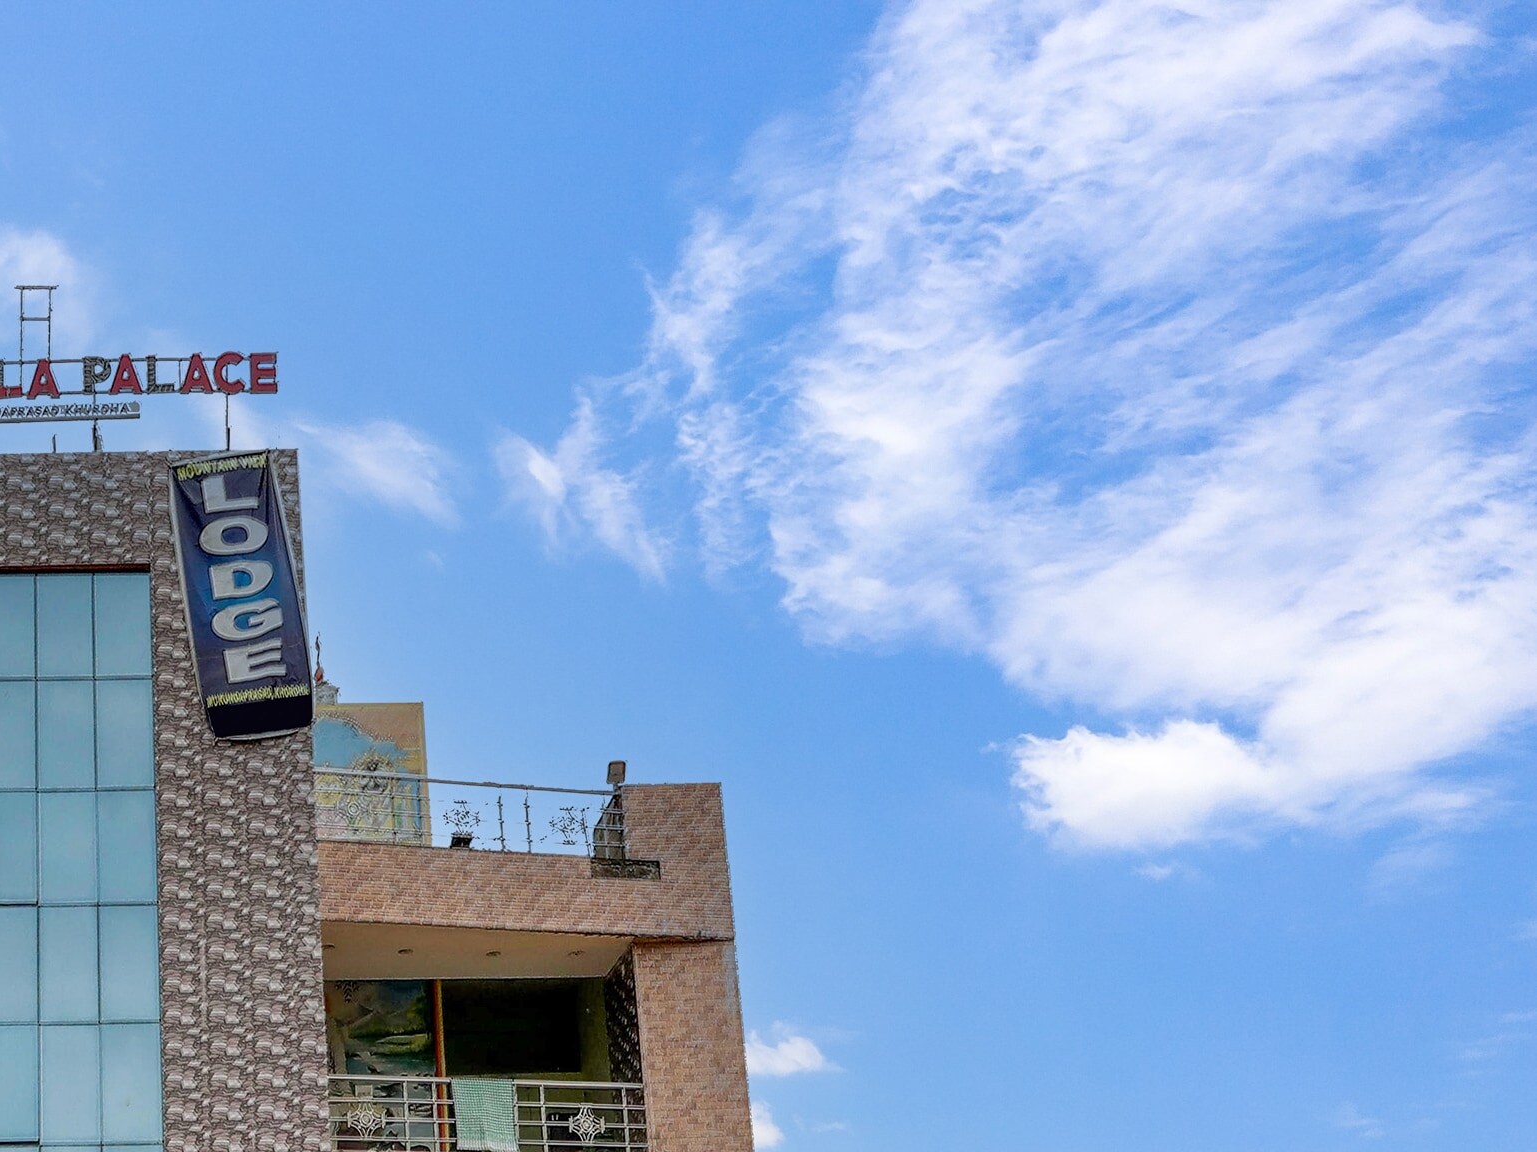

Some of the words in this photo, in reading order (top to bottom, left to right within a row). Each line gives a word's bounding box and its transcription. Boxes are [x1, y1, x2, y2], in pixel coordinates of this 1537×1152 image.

[82, 351, 279, 395] PALACE
[177, 459, 240, 480] MOUNTAIN
[199, 474, 287, 684] LODGE
